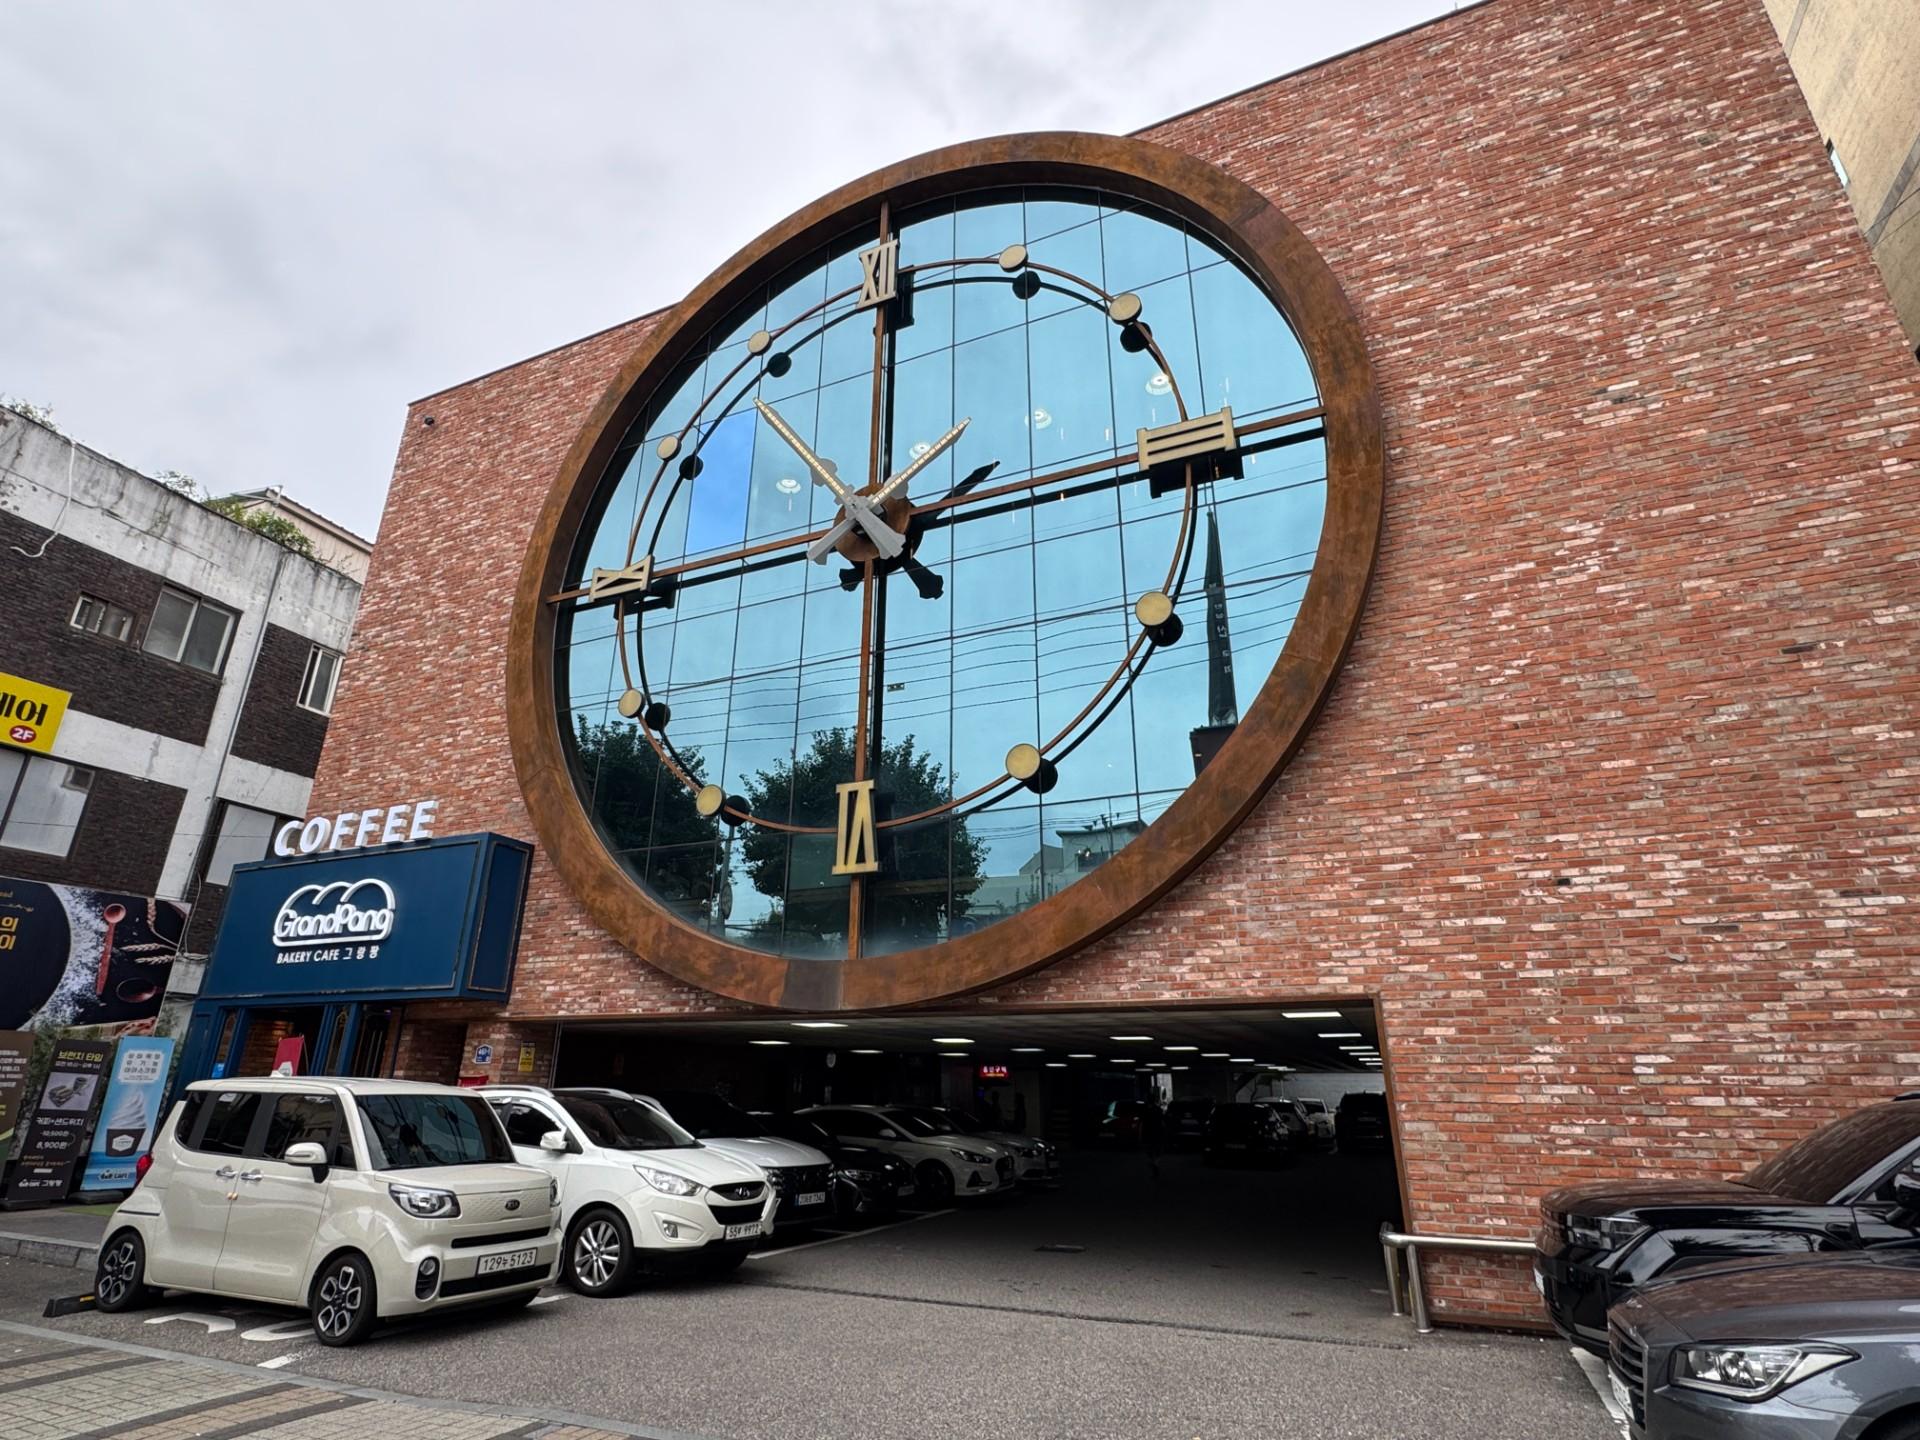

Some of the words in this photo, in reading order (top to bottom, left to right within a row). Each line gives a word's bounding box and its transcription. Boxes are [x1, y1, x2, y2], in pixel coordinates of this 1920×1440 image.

[856, 239, 898, 309] XII
[1137, 406, 1236, 472] III
[12, 727, 35, 740] 2F
[274, 800, 439, 857] COFFEE
[276, 951, 312, 964] BAKERY
[313, 948, 340, 962] CAFE
[57, 1051, 85, 1061] 브런치
[86, 1053, 104, 1062] 타임
